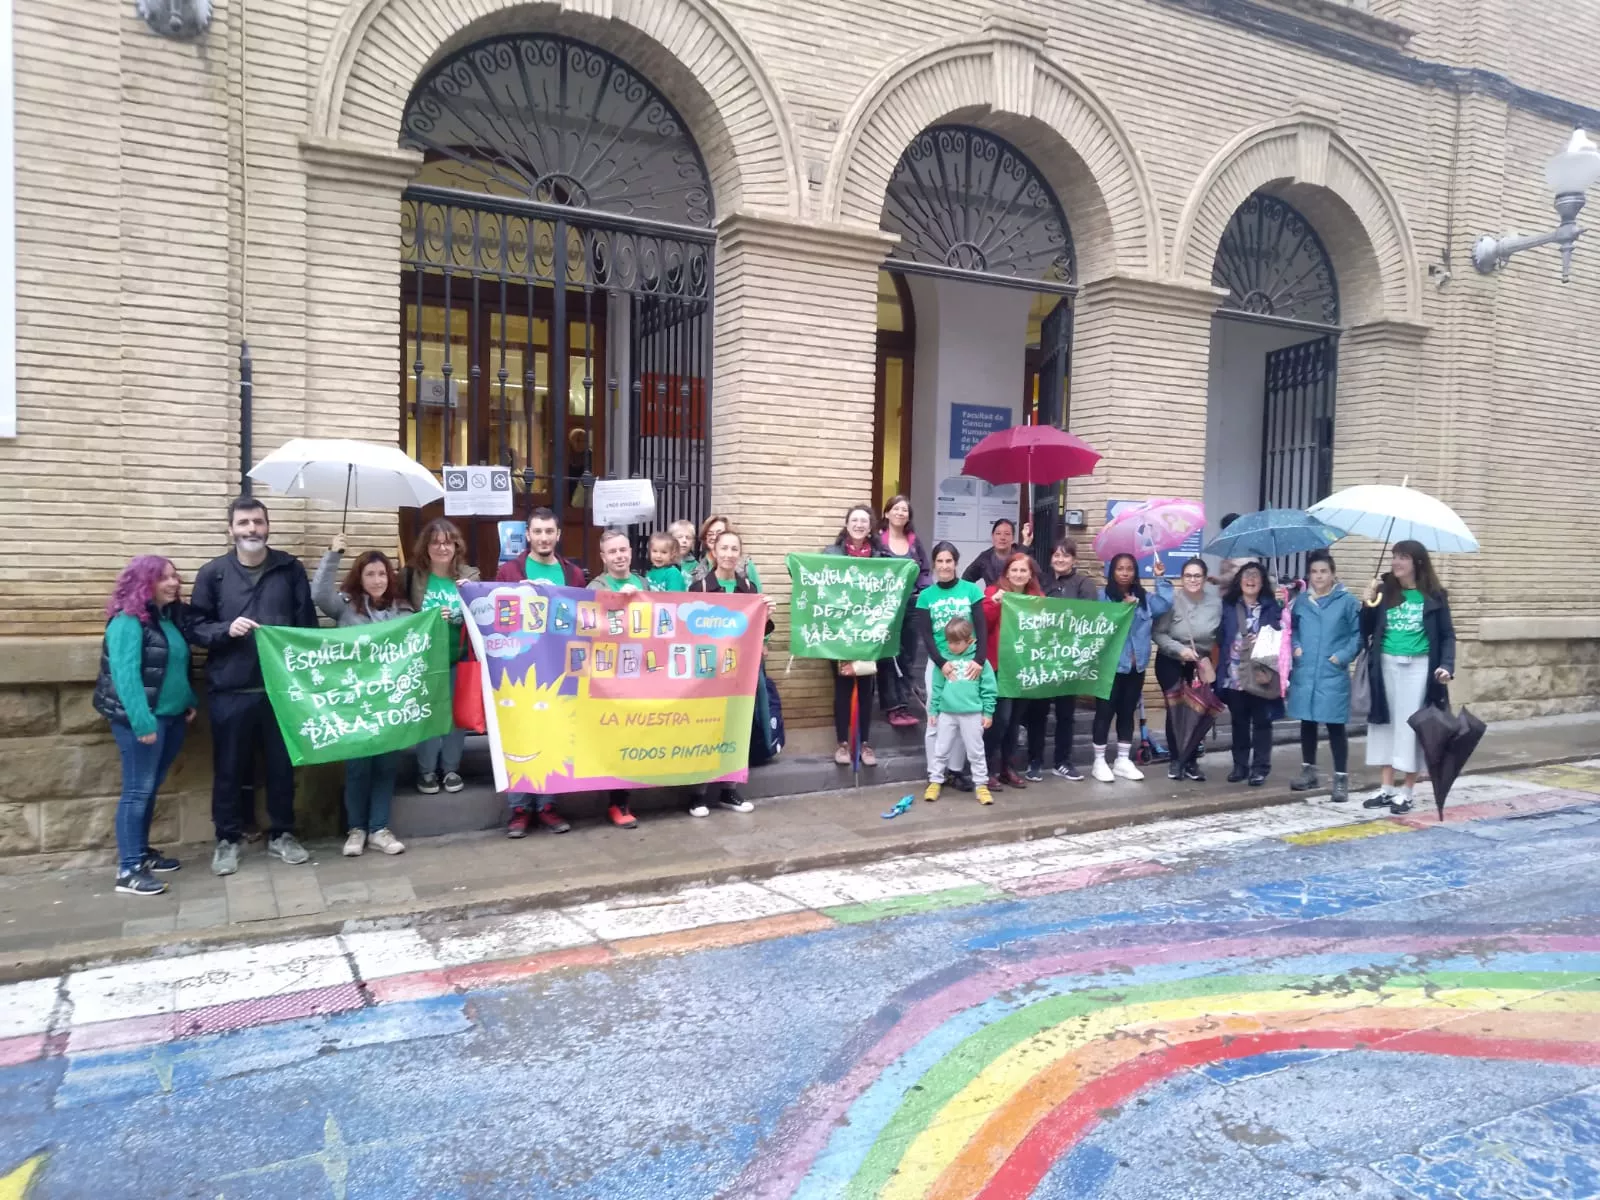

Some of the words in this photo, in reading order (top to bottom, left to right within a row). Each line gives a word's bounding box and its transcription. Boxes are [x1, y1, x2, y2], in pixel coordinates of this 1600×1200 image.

[800, 569, 854, 587] ESCUELA
[498, 600, 673, 635] ESCUELA
[813, 604, 834, 617] DE
[1019, 612, 1065, 631] ESCUELA
[804, 628, 846, 644] PARA
[285, 641, 361, 672] ESCUELA
[369, 633, 431, 664] PÚBLICA
[1031, 648, 1047, 661] DE
[1022, 670, 1058, 687] PARA
[311, 689, 341, 709] DE
[600, 712, 619, 726] LA
[625, 712, 690, 727] NUESTRA
[308, 715, 371, 744] PARA
[620, 746, 666, 761] TODOS
[671, 741, 737, 759] PINTAMOS
